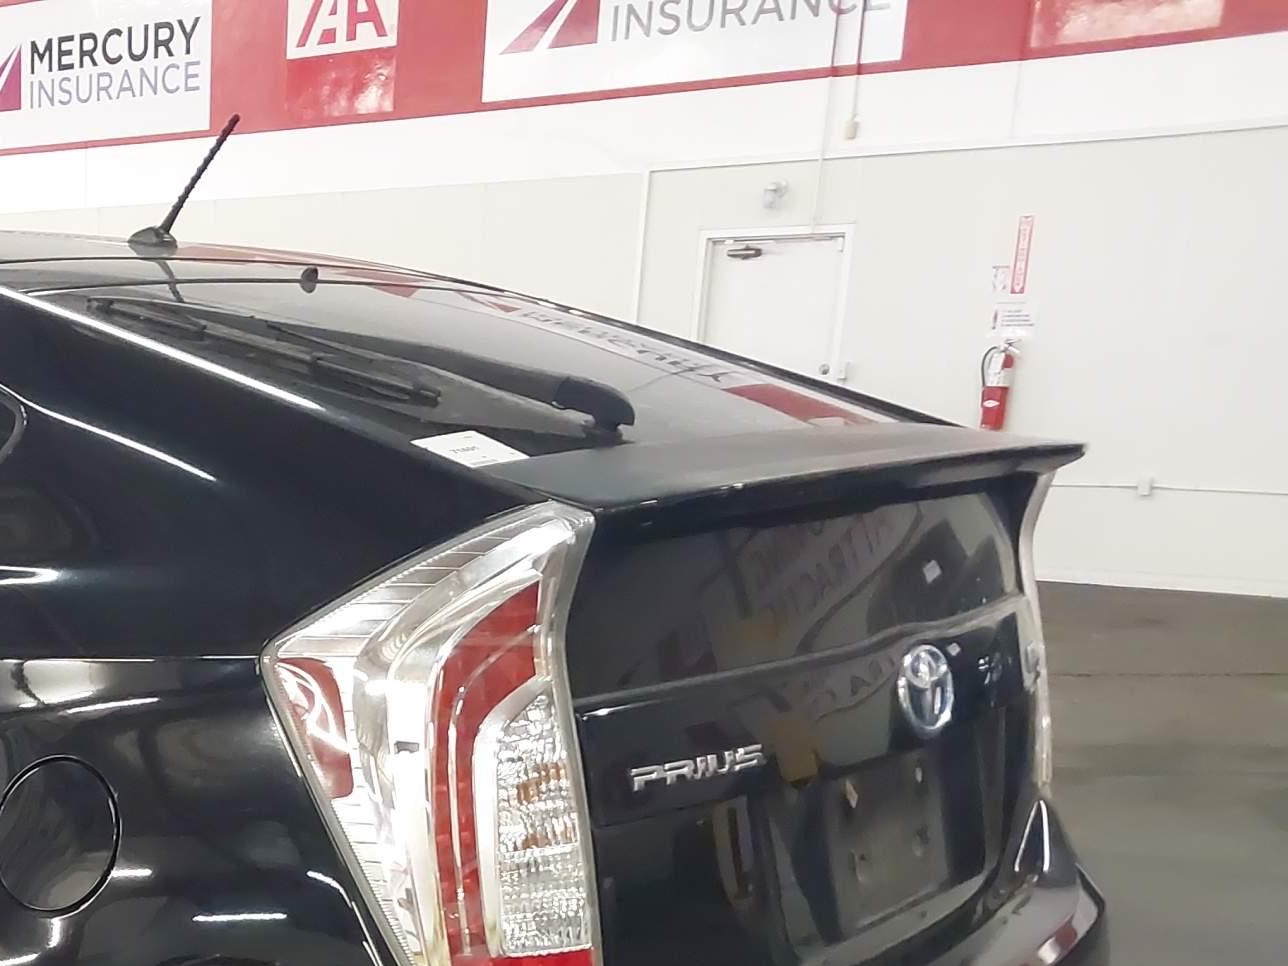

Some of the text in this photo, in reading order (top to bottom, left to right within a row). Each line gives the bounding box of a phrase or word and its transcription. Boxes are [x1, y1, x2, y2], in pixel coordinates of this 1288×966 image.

[30, 16, 201, 74] MERCURY
[30, 60, 201, 109] INSURANCE
[631, 744, 767, 792] PRIUS
